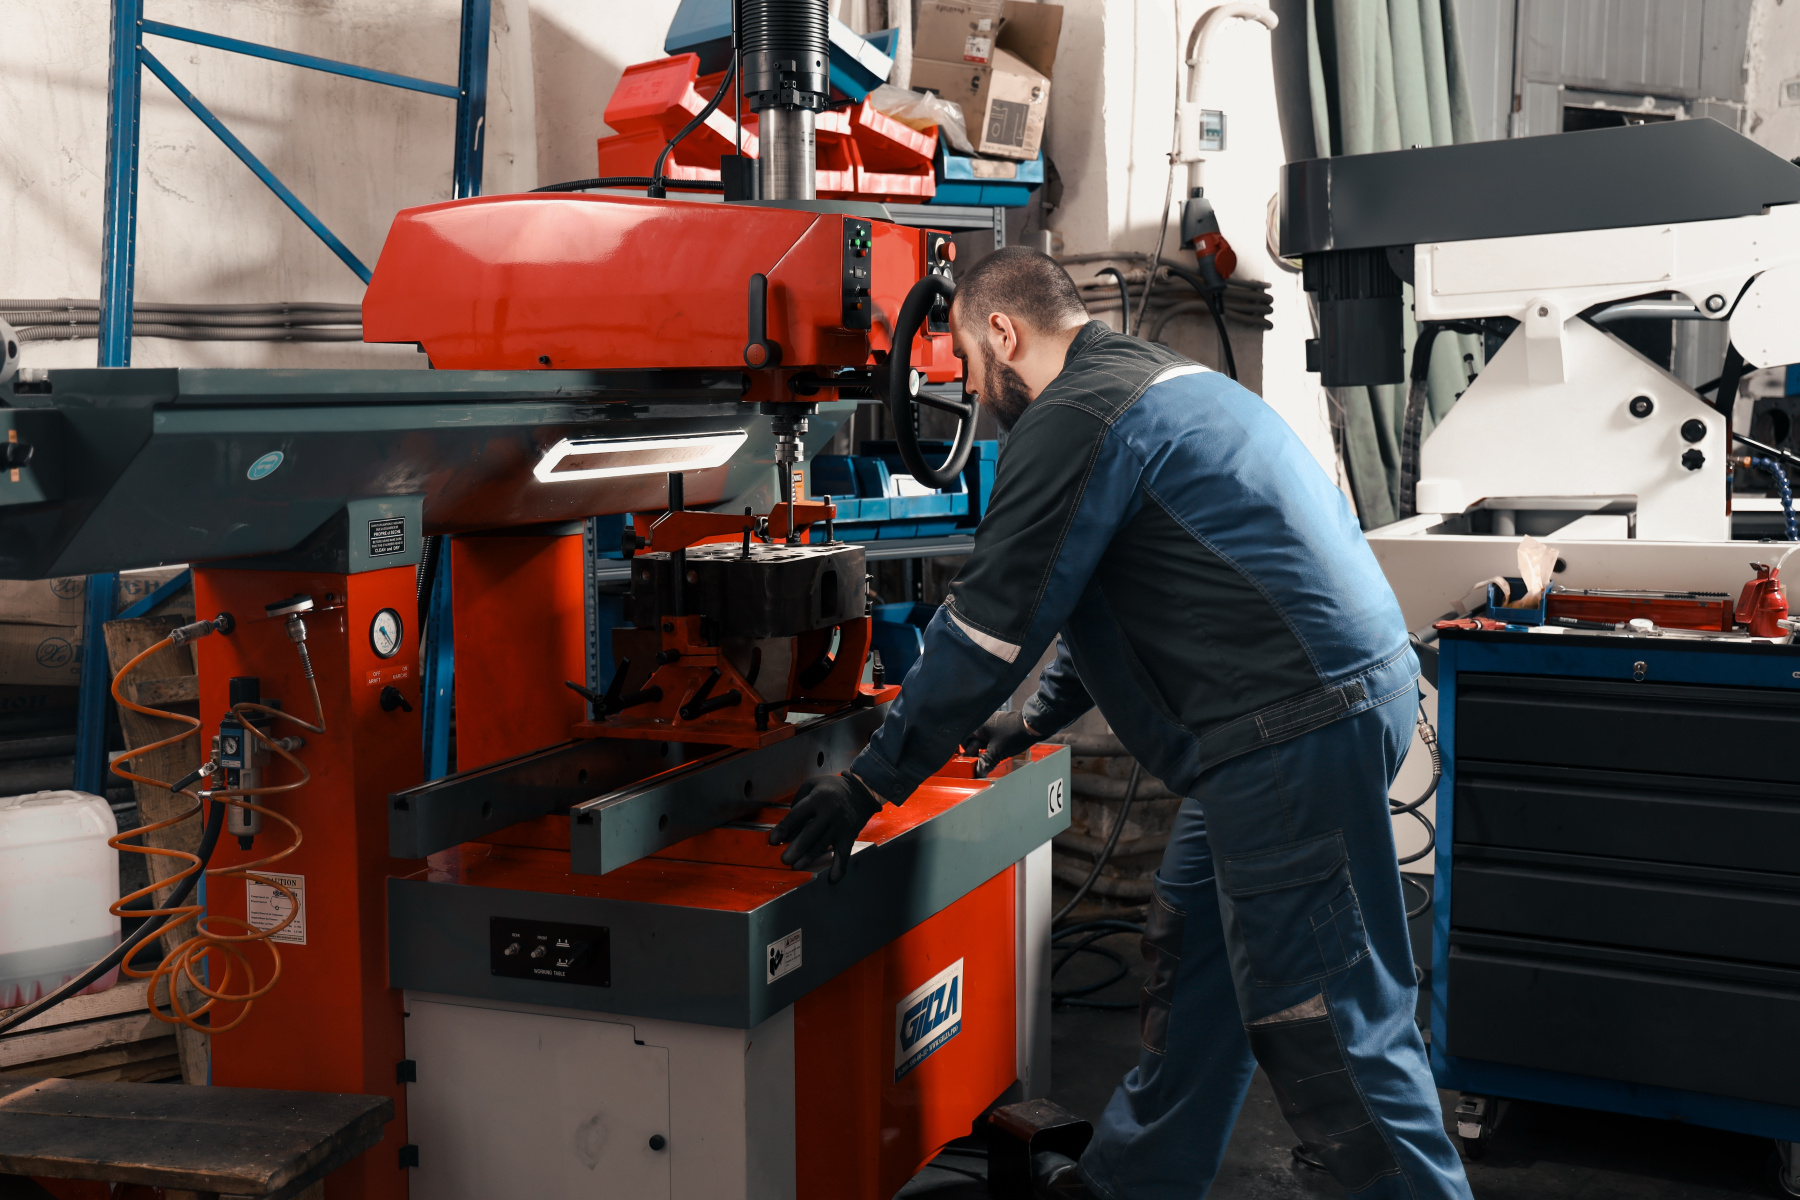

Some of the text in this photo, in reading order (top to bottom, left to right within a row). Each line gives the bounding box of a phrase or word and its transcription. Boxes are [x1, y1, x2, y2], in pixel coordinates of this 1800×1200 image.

[1049, 781, 1062, 813] CE
[533, 968, 553, 976] WORKING
[900, 975, 959, 1053] GILZA
